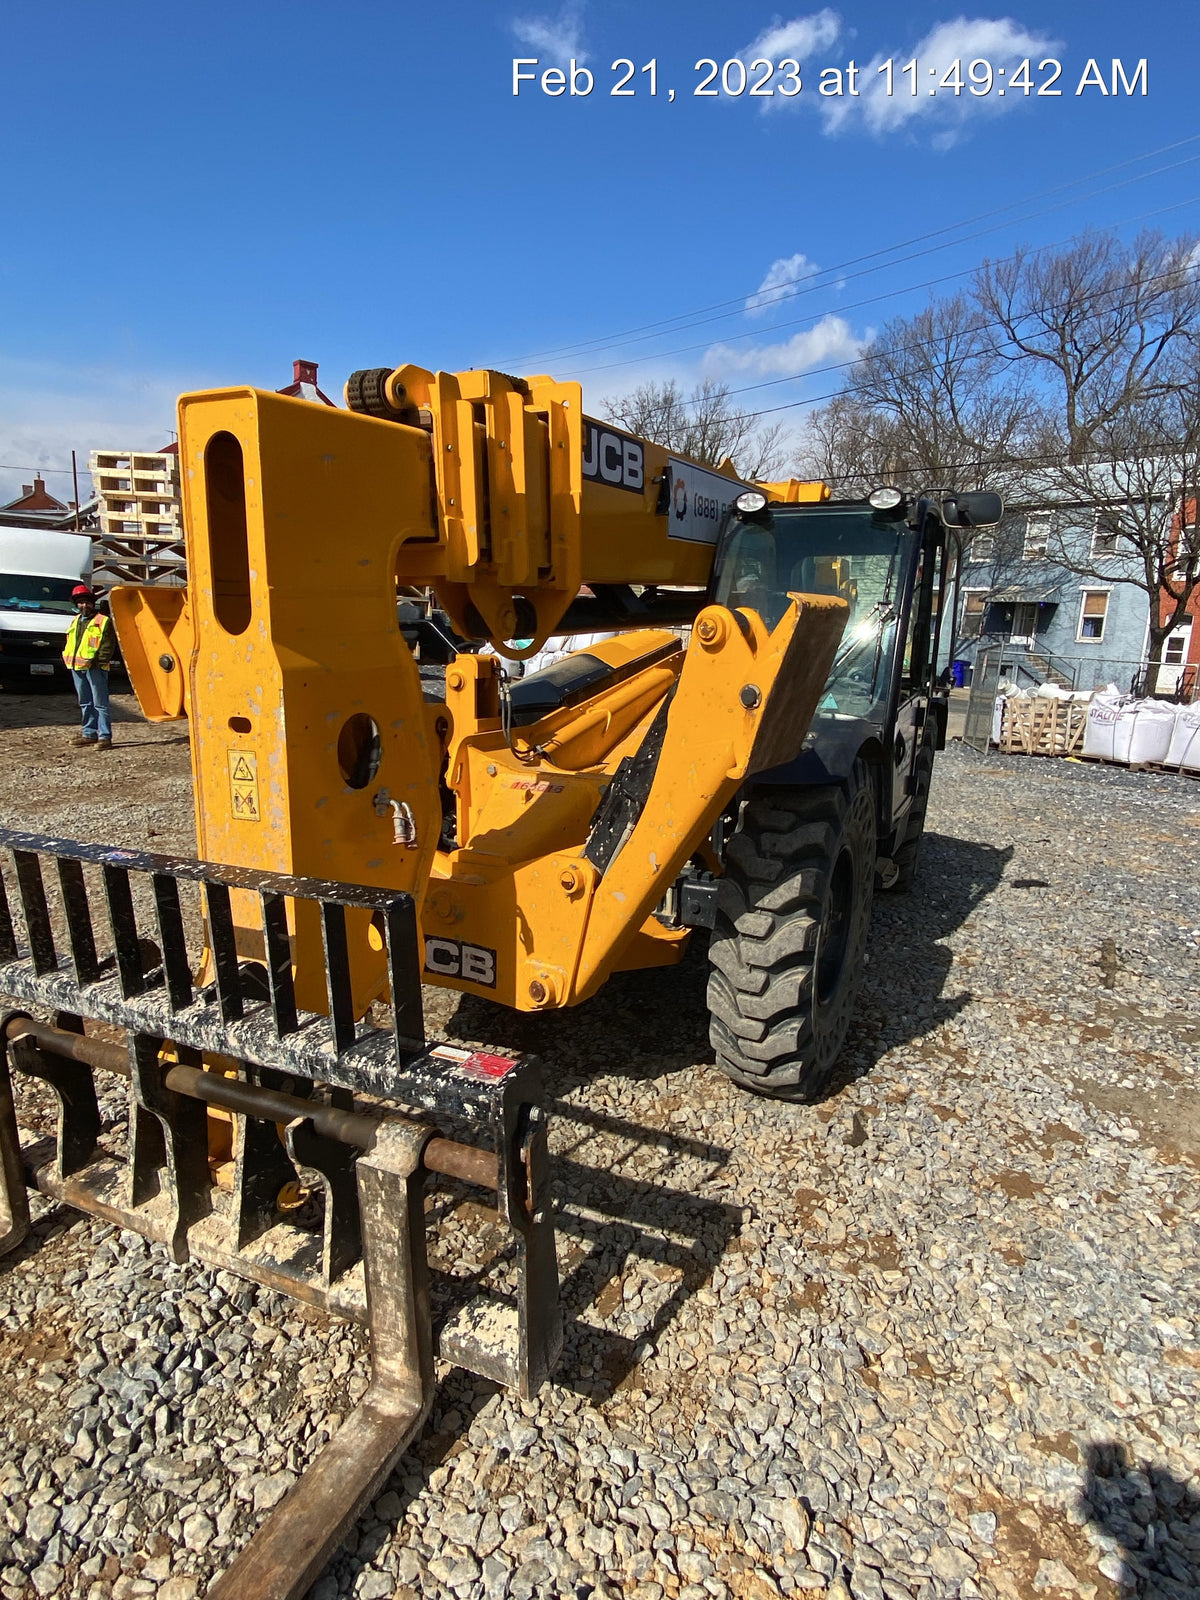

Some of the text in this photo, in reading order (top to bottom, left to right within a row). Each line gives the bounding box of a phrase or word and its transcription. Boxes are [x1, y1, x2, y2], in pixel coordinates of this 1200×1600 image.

[581, 427, 644, 489] JCB
[693, 492, 719, 522] (888)
[424, 939, 495, 984] CB
